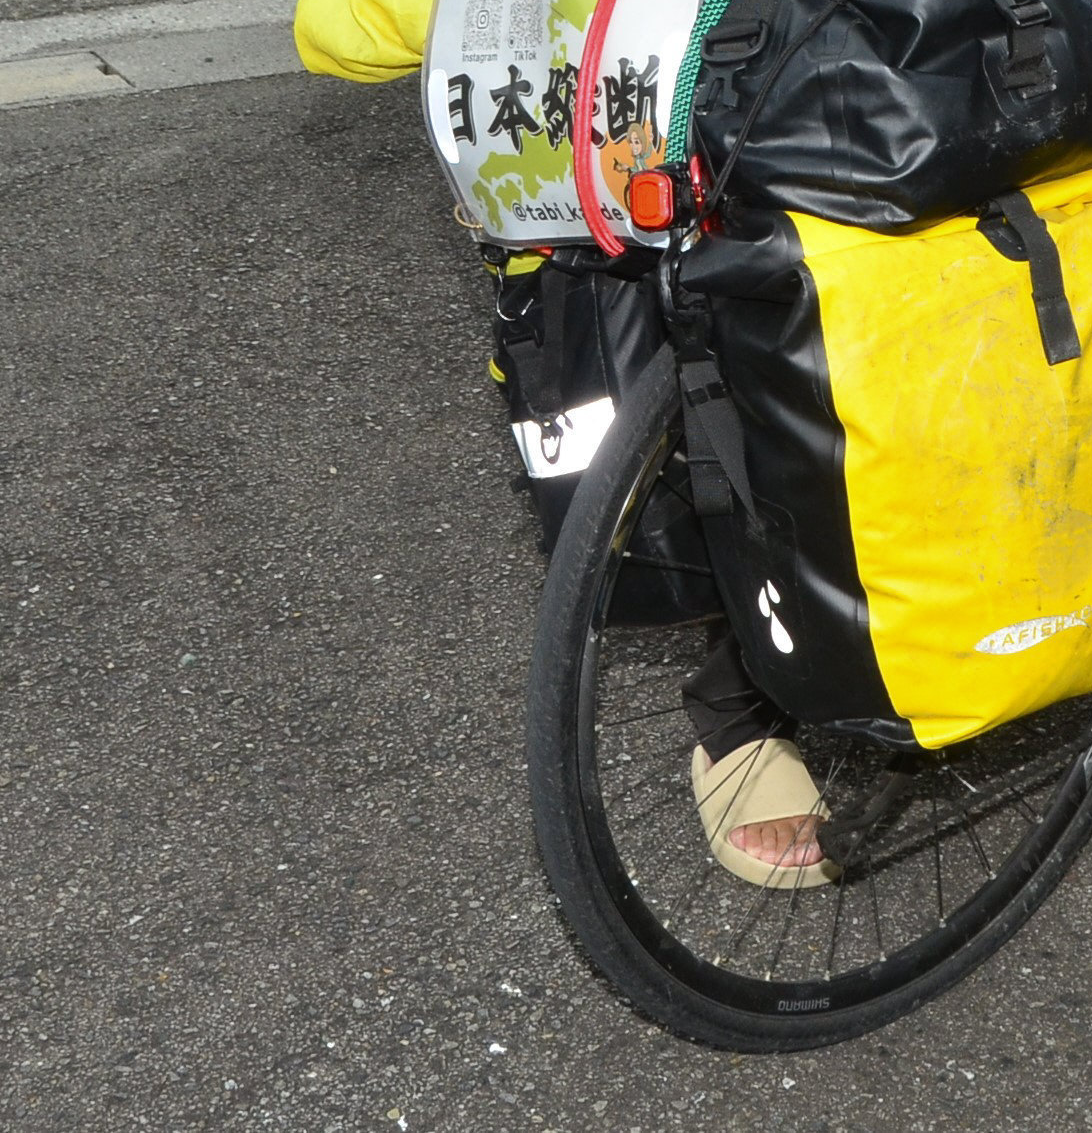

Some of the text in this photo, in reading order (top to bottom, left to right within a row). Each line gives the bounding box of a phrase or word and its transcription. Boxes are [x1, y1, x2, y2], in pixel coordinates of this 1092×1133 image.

[461, 50, 537, 64] Instagram TikTok
[777, 997, 830, 1012] SHIMANO
